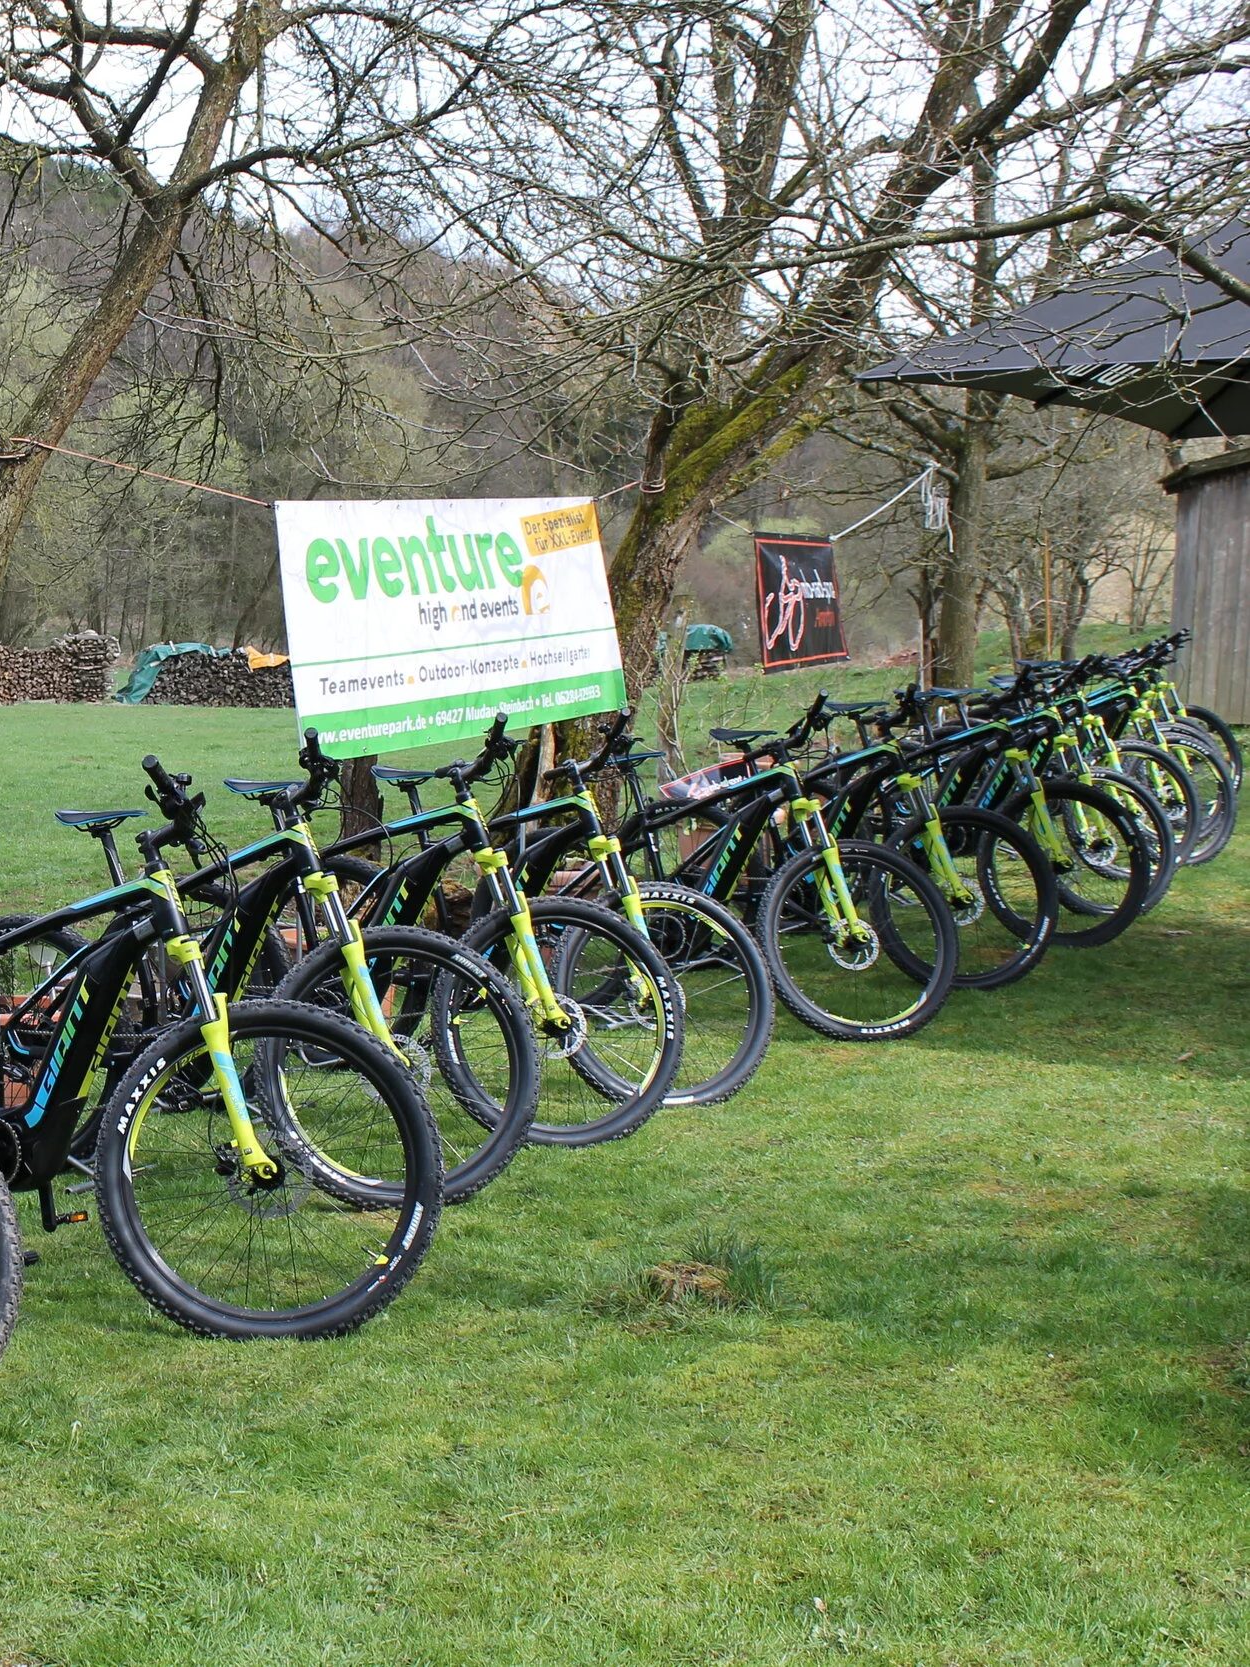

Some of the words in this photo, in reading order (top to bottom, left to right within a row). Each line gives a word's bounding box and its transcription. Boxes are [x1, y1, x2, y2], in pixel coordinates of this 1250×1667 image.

[524, 520, 541, 536] Der
[542, 511, 584, 533] Spezialist
[305, 515, 524, 604] eventure
[418, 600, 448, 631] high
[480, 595, 519, 619] events
[319, 669, 405, 696] Teamevents
[418, 654, 519, 683] Outdoor-Konzepte
[435, 707, 464, 728] 69427
[639, 891, 696, 905] MAXXIS
[655, 975, 675, 1041] MAXXIS
[34, 973, 91, 1110] GIANT
[116, 1056, 167, 1136] MAXXIS
